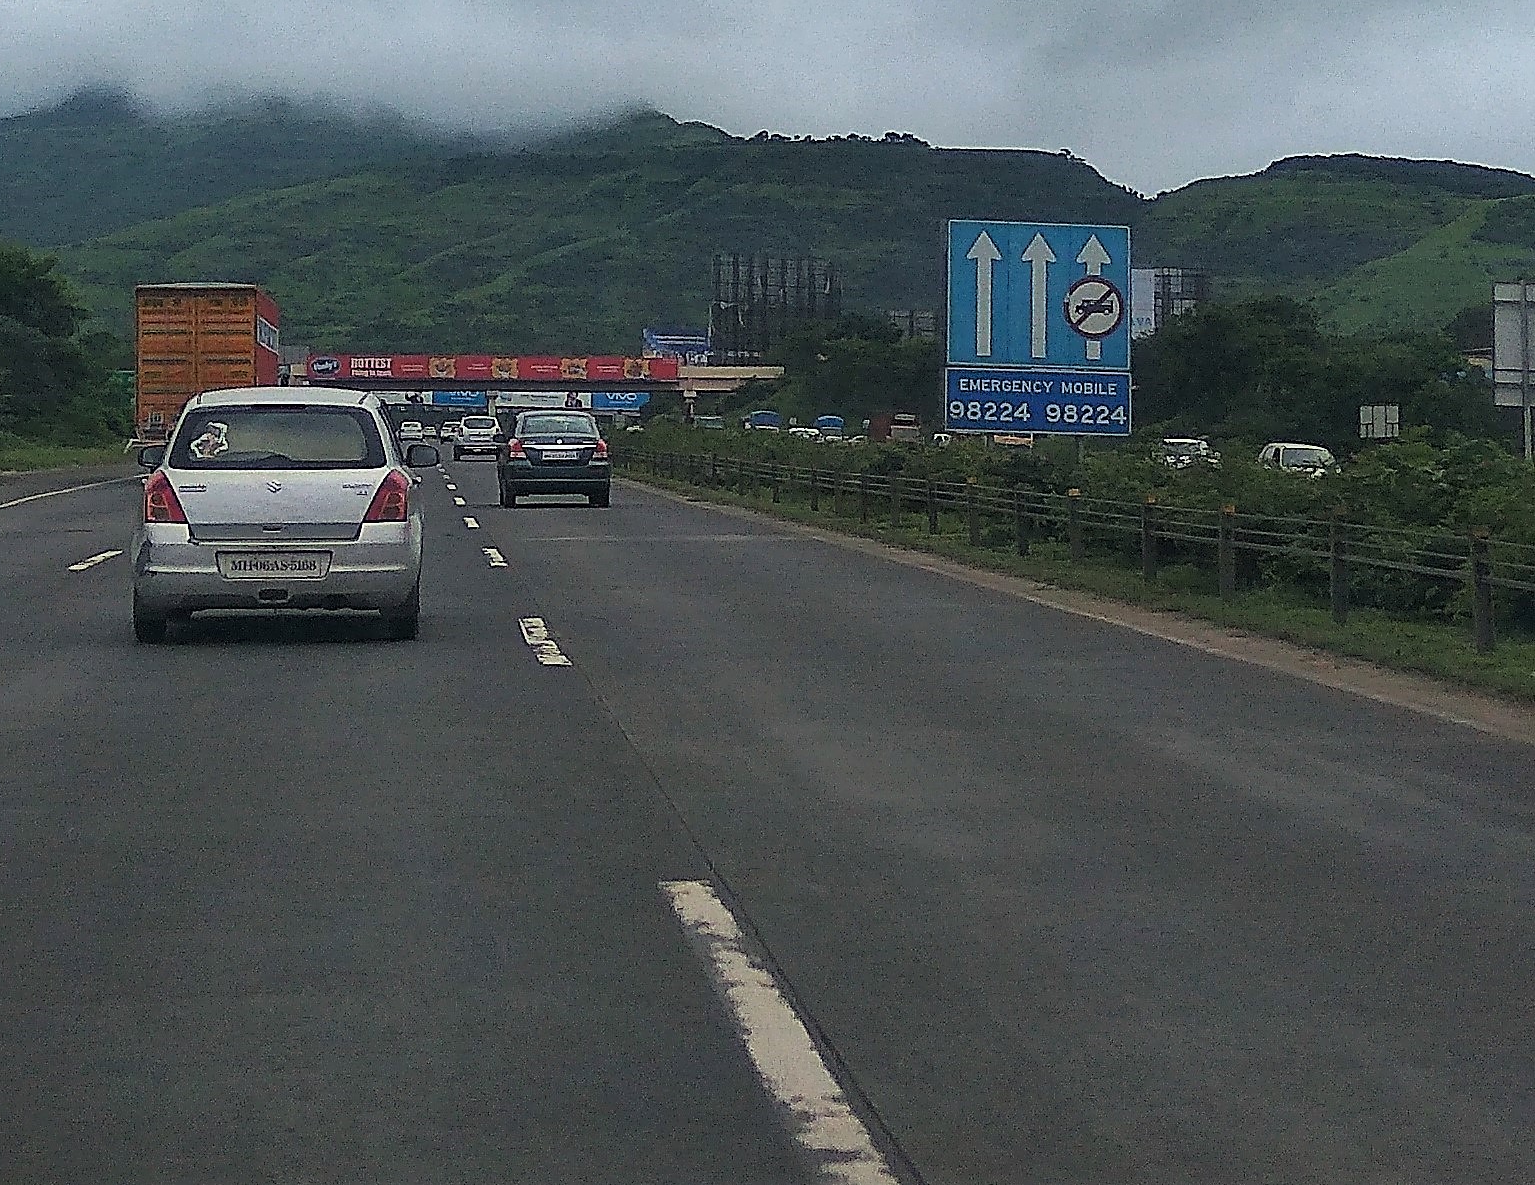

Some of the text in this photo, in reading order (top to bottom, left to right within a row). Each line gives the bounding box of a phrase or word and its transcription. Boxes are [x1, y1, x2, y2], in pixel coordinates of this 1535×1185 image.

[350, 357, 392, 369] HOTTEST
[959, 378, 1118, 396] EMERGENCY MOBILE
[949, 400, 1127, 425] 98224 98224
